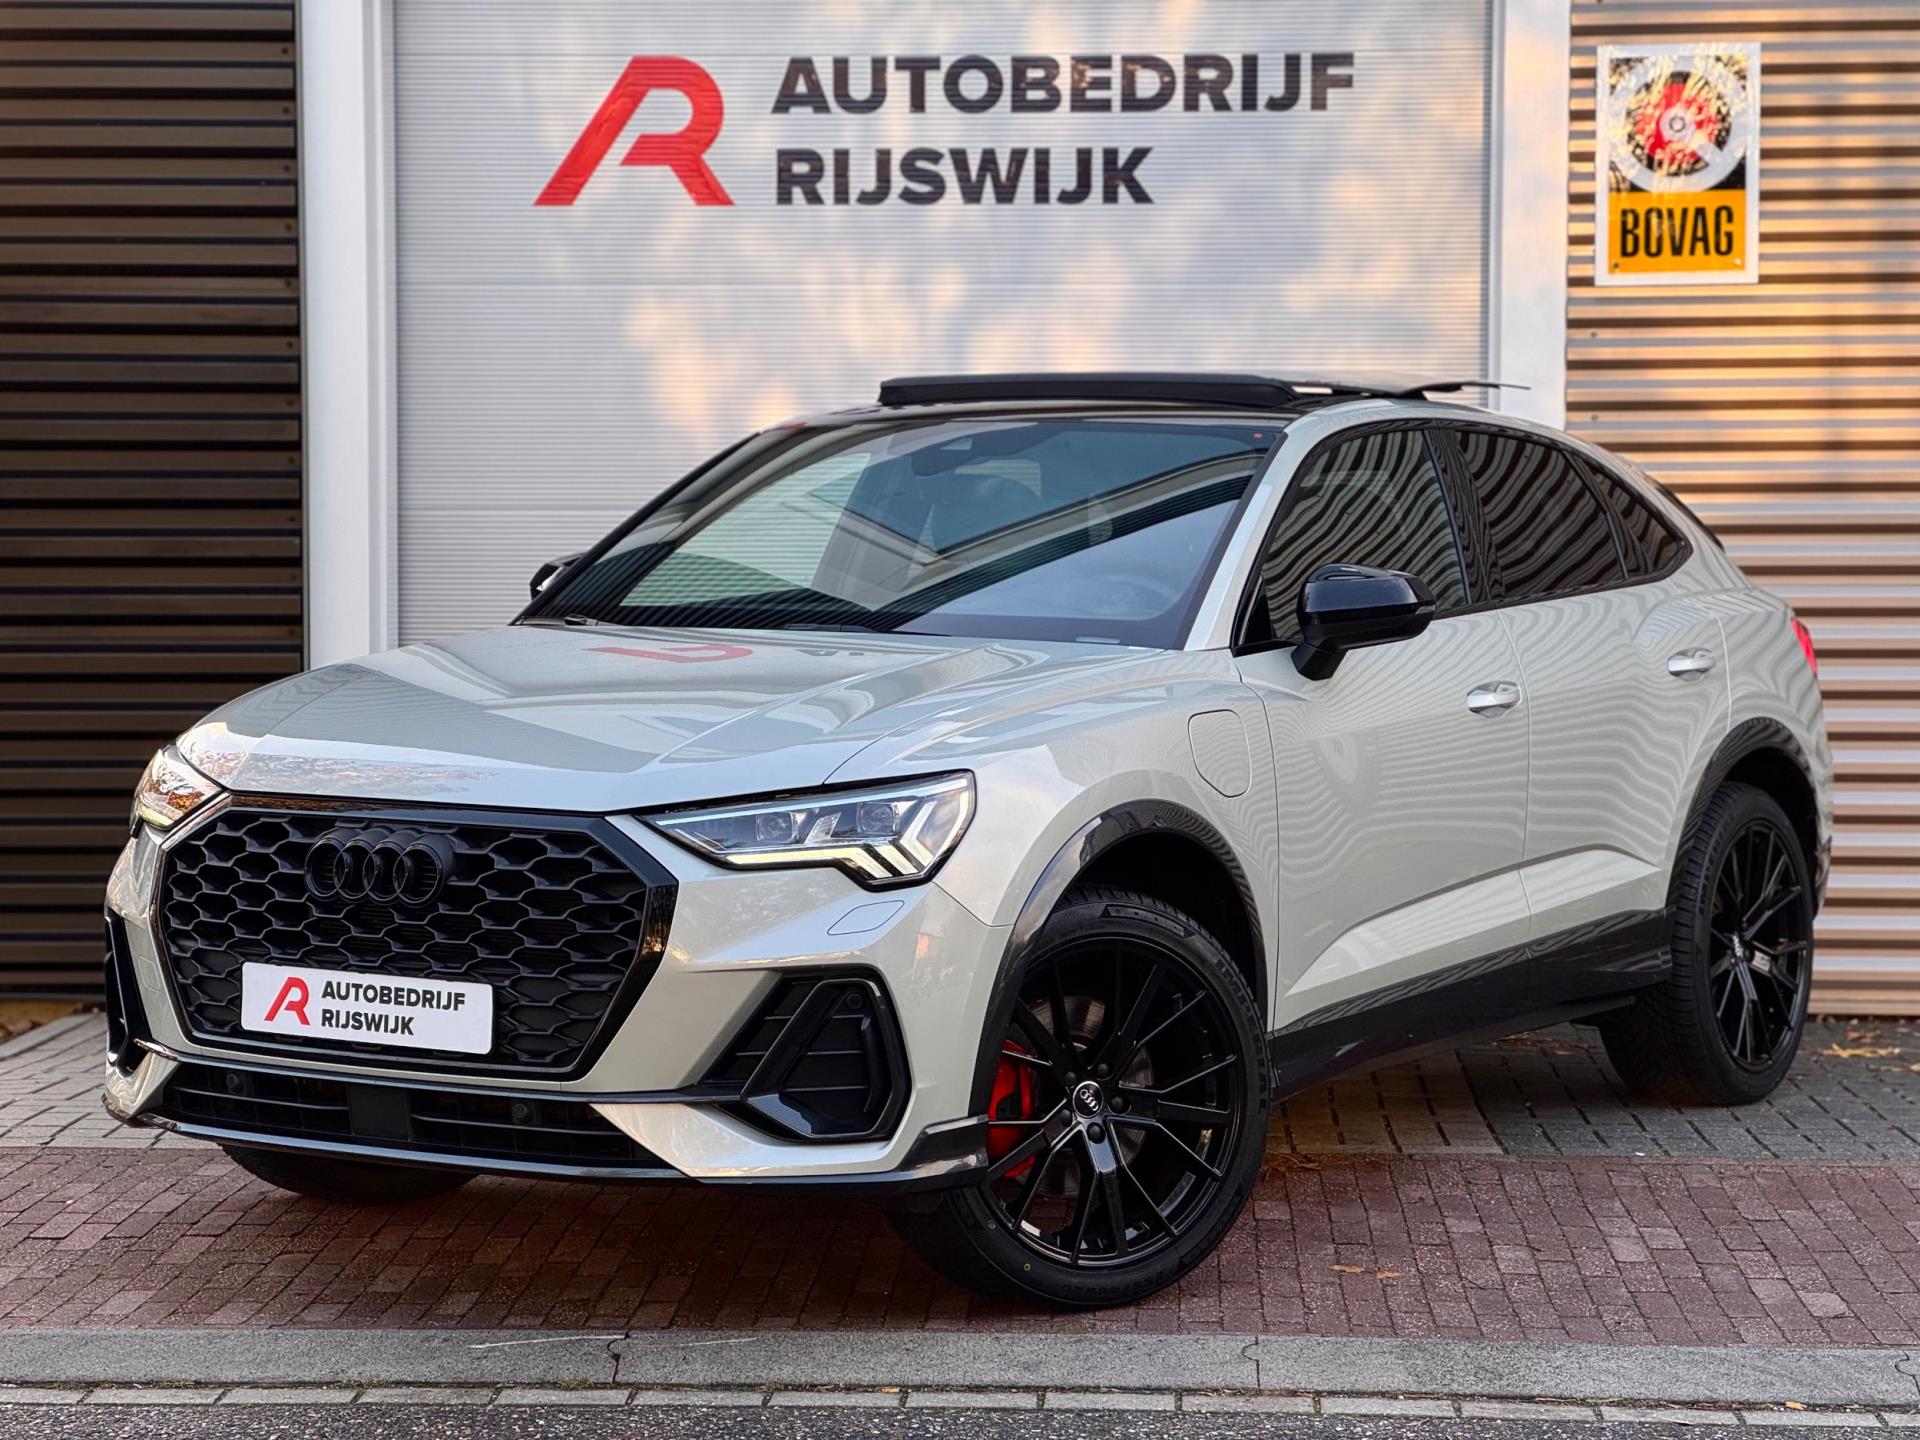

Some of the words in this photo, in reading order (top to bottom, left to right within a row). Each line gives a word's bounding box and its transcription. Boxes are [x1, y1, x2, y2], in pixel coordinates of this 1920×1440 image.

[772, 52, 1355, 114] AUTOBEDRIJF
[775, 147, 1154, 205] RIJSWIJK
[1620, 205, 1734, 258] BOVAG
[321, 980, 466, 1011] AUTOBEDRIJF
[321, 1008, 415, 1036] RIJSWIJK
